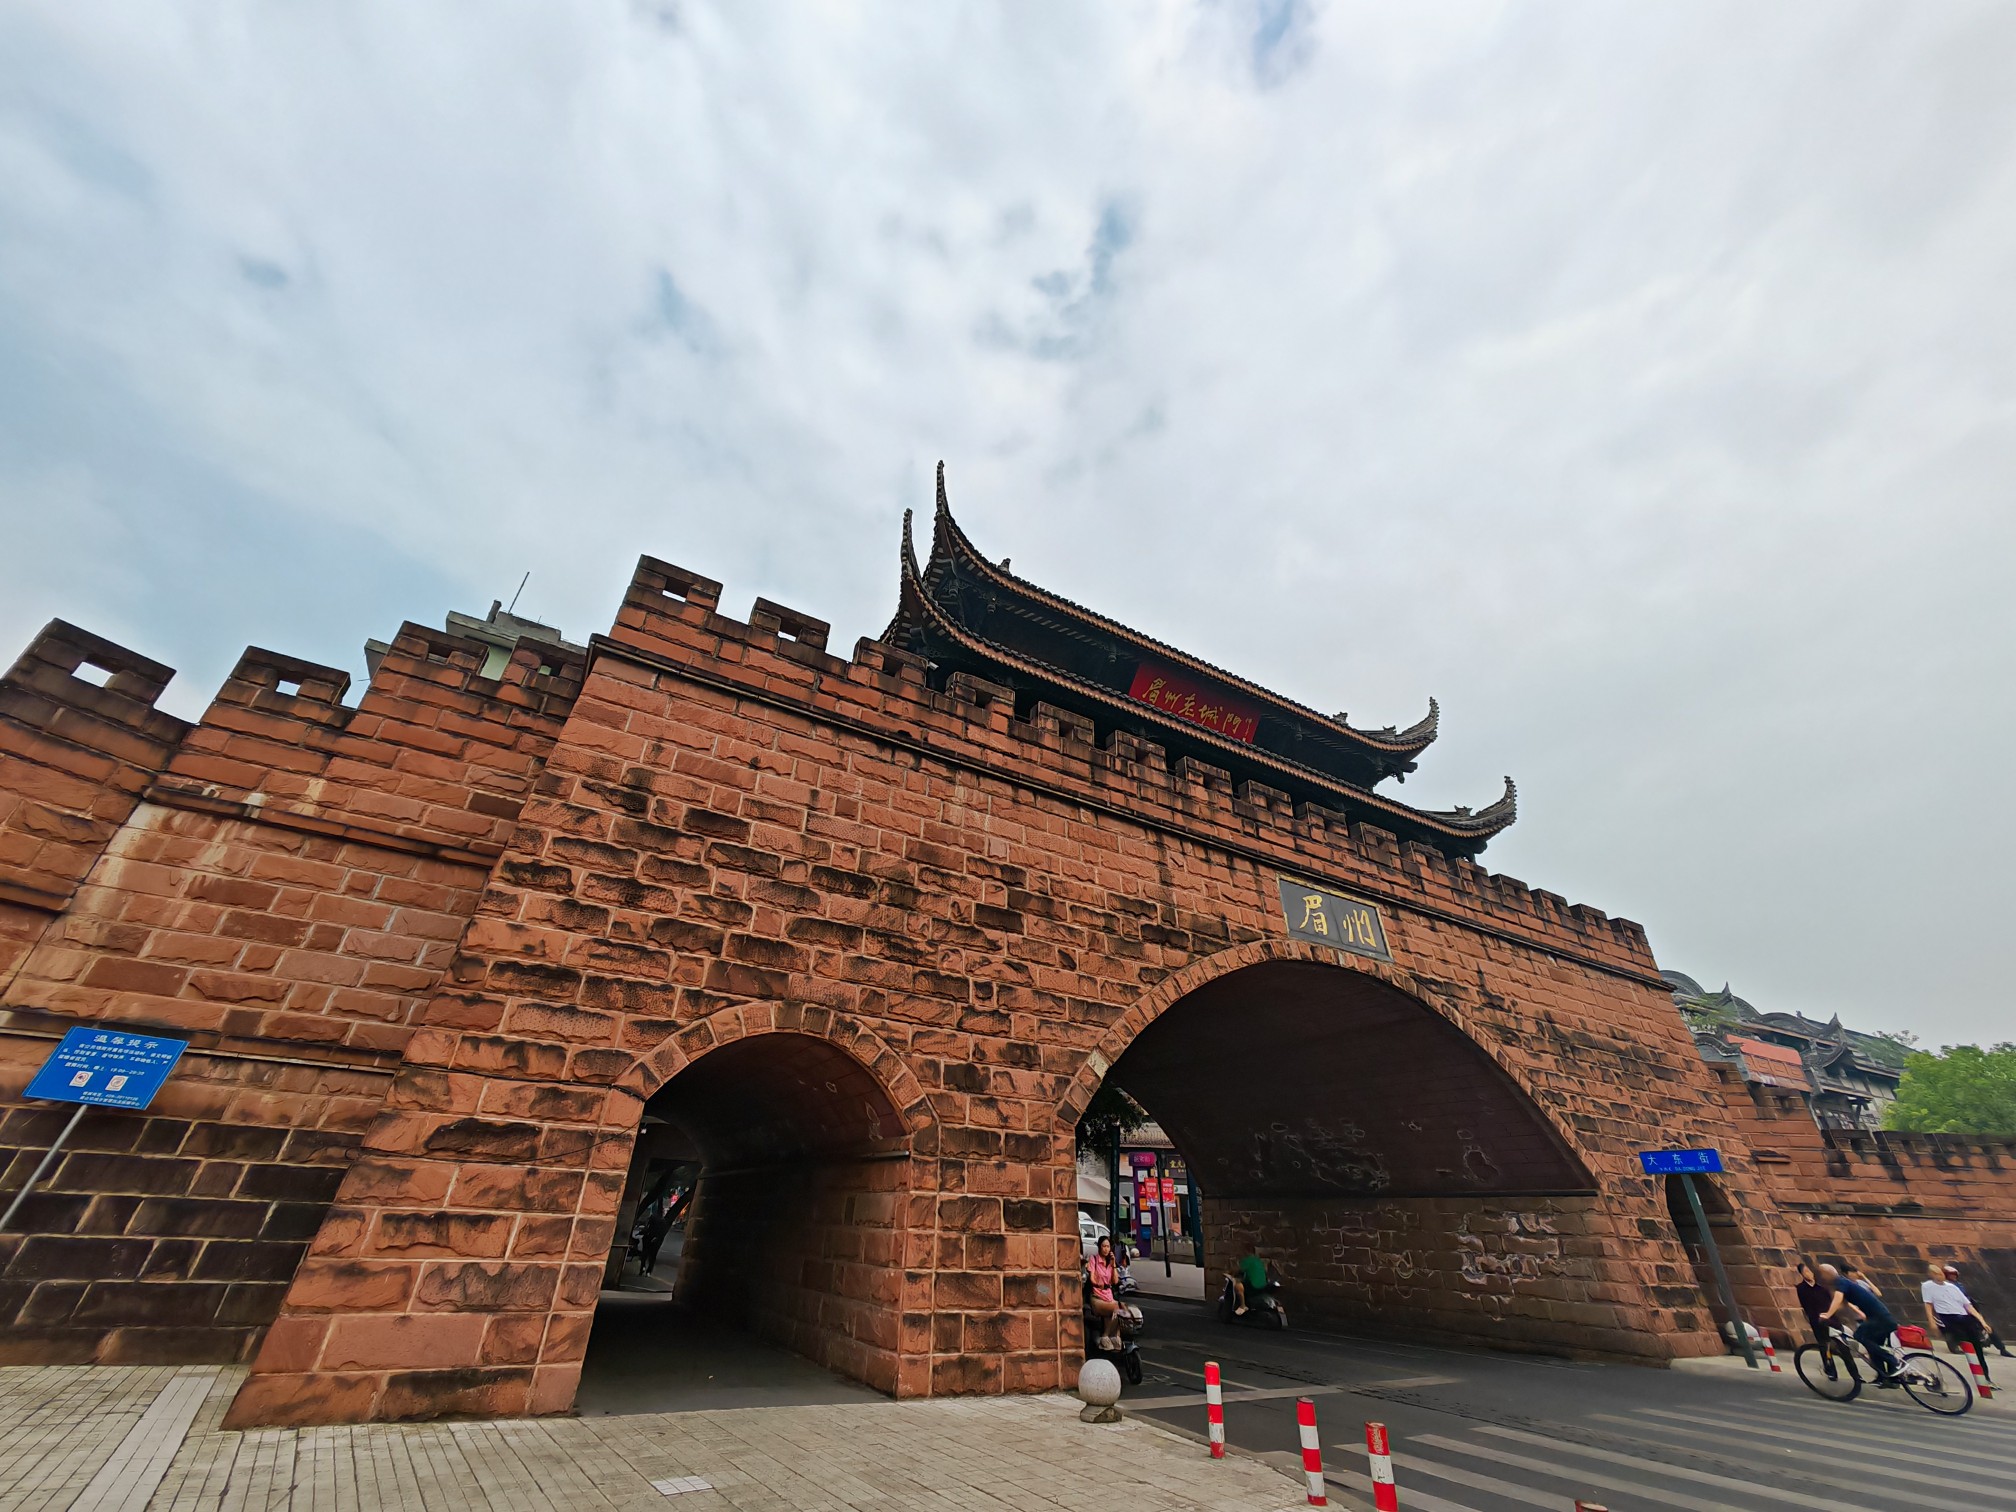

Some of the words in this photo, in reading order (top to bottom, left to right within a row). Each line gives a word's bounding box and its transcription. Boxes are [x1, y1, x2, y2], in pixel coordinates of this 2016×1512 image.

[1299, 894, 1377, 948] 眉州
[93, 1034, 159, 1050] 温馨提示
[1647, 1152, 1710, 1166] 大东街
